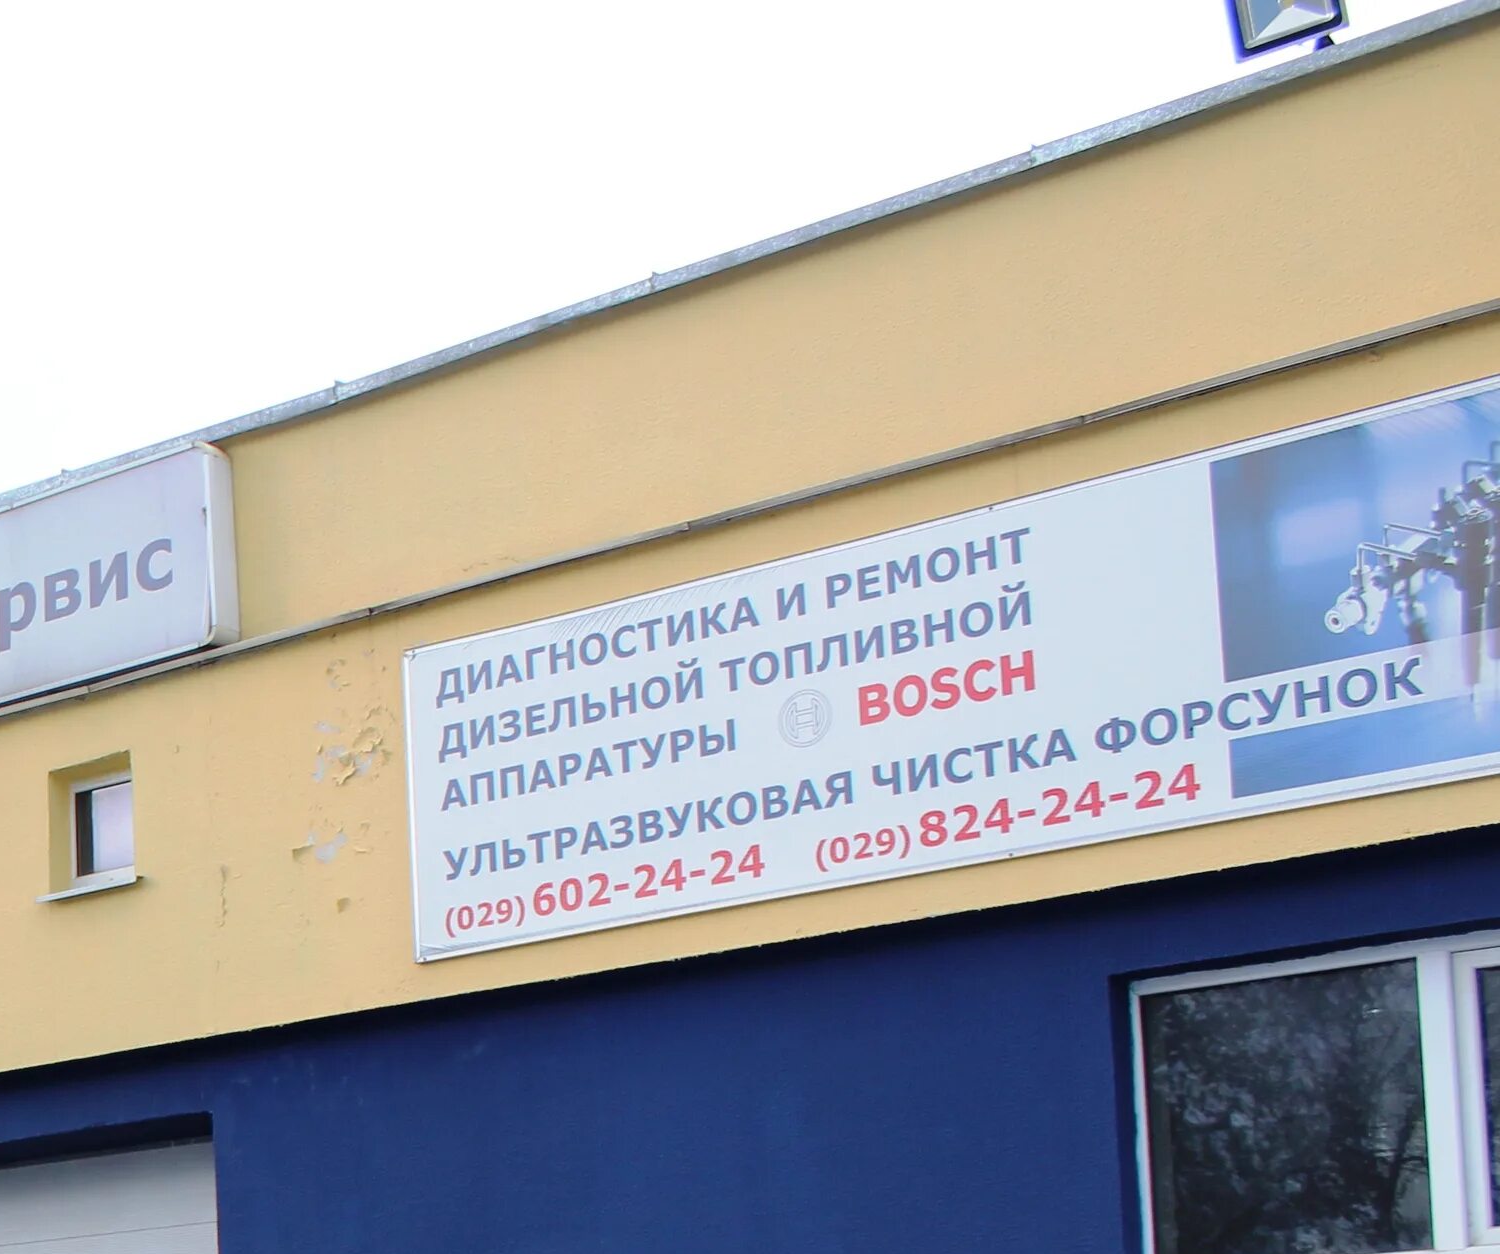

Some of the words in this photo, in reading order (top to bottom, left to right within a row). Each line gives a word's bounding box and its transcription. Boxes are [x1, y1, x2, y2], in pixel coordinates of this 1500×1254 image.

[436, 597, 759, 708] ДИАГНОСТИКА
[776, 583, 807, 621] И
[826, 527, 1031, 609] РЕМОНТ
[438, 660, 704, 763] ДИЗЕЛЬНОЙ
[720, 580, 1033, 693] ТОПЛИВНОЙ
[857, 649, 1037, 727] BOSCH
[441, 719, 737, 811] АППАРАТУРЫ
[443, 770, 854, 881] УЛЬТРАЗВУКОВАЯ
[871, 728, 1077, 796] ЧИСТКА
[1094, 656, 1424, 755] ФОРСУНОК
[815, 824, 911, 872] (029)
[919, 763, 1201, 848] 824-24-24
[445, 895, 526, 938] (029)
[532, 844, 766, 917] 602-24-24
